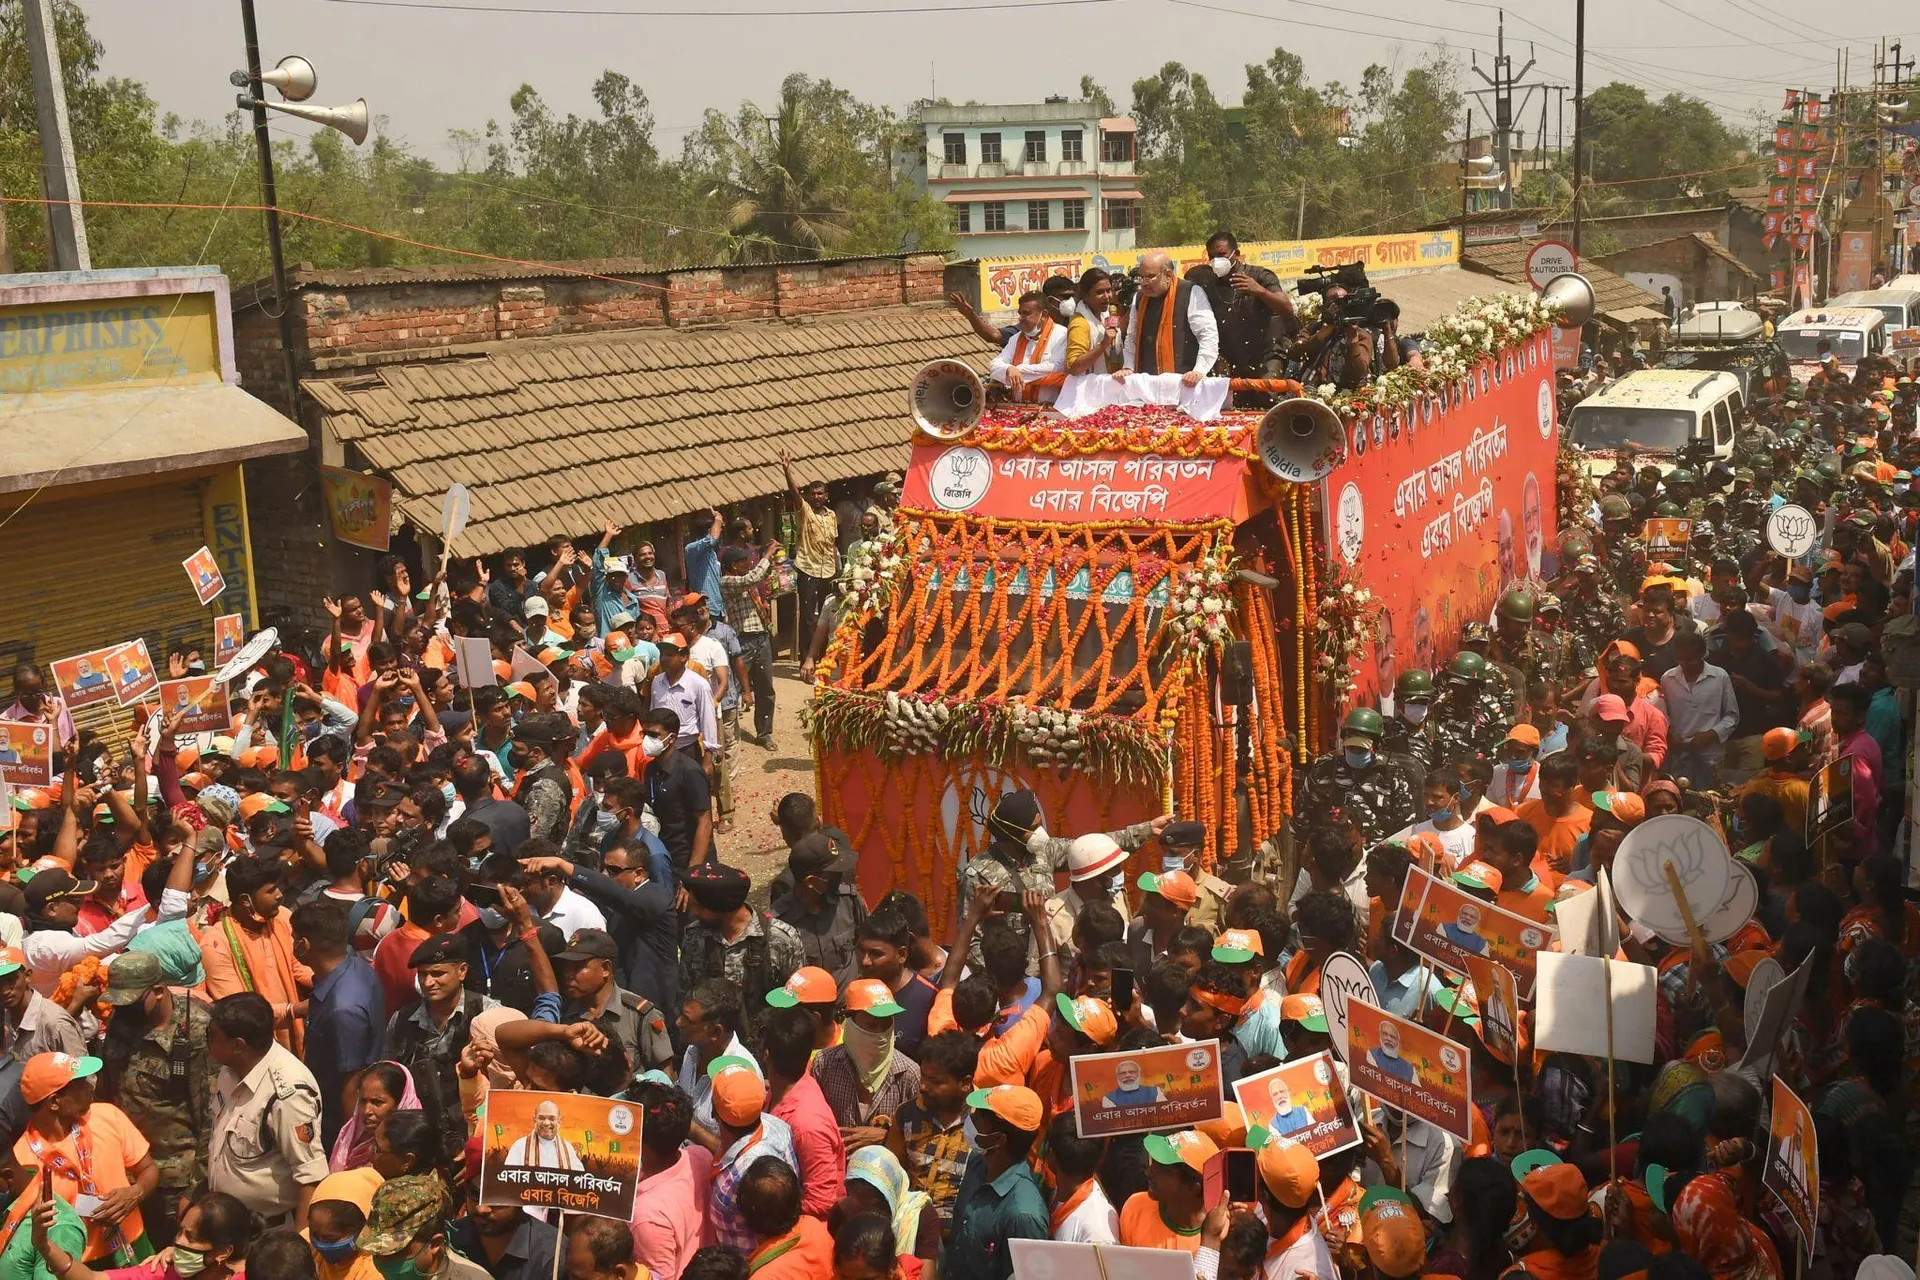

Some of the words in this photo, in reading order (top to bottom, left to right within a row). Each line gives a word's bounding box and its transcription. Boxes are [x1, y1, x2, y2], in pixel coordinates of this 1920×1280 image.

[1376, 240, 1416, 264] গ্যাস
[1540, 257, 1562, 265] DRIVE
[1529, 265, 1574, 274] CAUTIOUSLY
[1000, 457, 1051, 480] এবার
[1058, 457, 1117, 482] আসল
[1266, 445, 1301, 478] Haldia
[1394, 469, 1427, 519] এবার
[1428, 450, 1464, 497] আসল
[1465, 415, 1509, 477] পরিবর্তন
[1030, 489, 1084, 512] এবার
[1090, 483, 1170, 513] বিজেপি
[1420, 511, 1452, 560] এবার
[1453, 476, 1495, 542] বিজেপি
[1424, 933, 1448, 950] এবার
[1359, 1064, 1382, 1082] এবার
[1384, 1073, 1412, 1097] আসল
[1415, 1090, 1457, 1118] পরিবর্তন
[1092, 1109, 1121, 1121] এবার
[1126, 1106, 1157, 1117] আসল
[1161, 1098, 1208, 1113] পরিবর্তন
[497, 1169, 530, 1183] এবার
[535, 1170, 569, 1187] আসল
[574, 1173, 622, 1195] পরিবর্তন
[520, 1188, 553, 1202] এবার
[557, 1188, 600, 1210] বিজেপি
